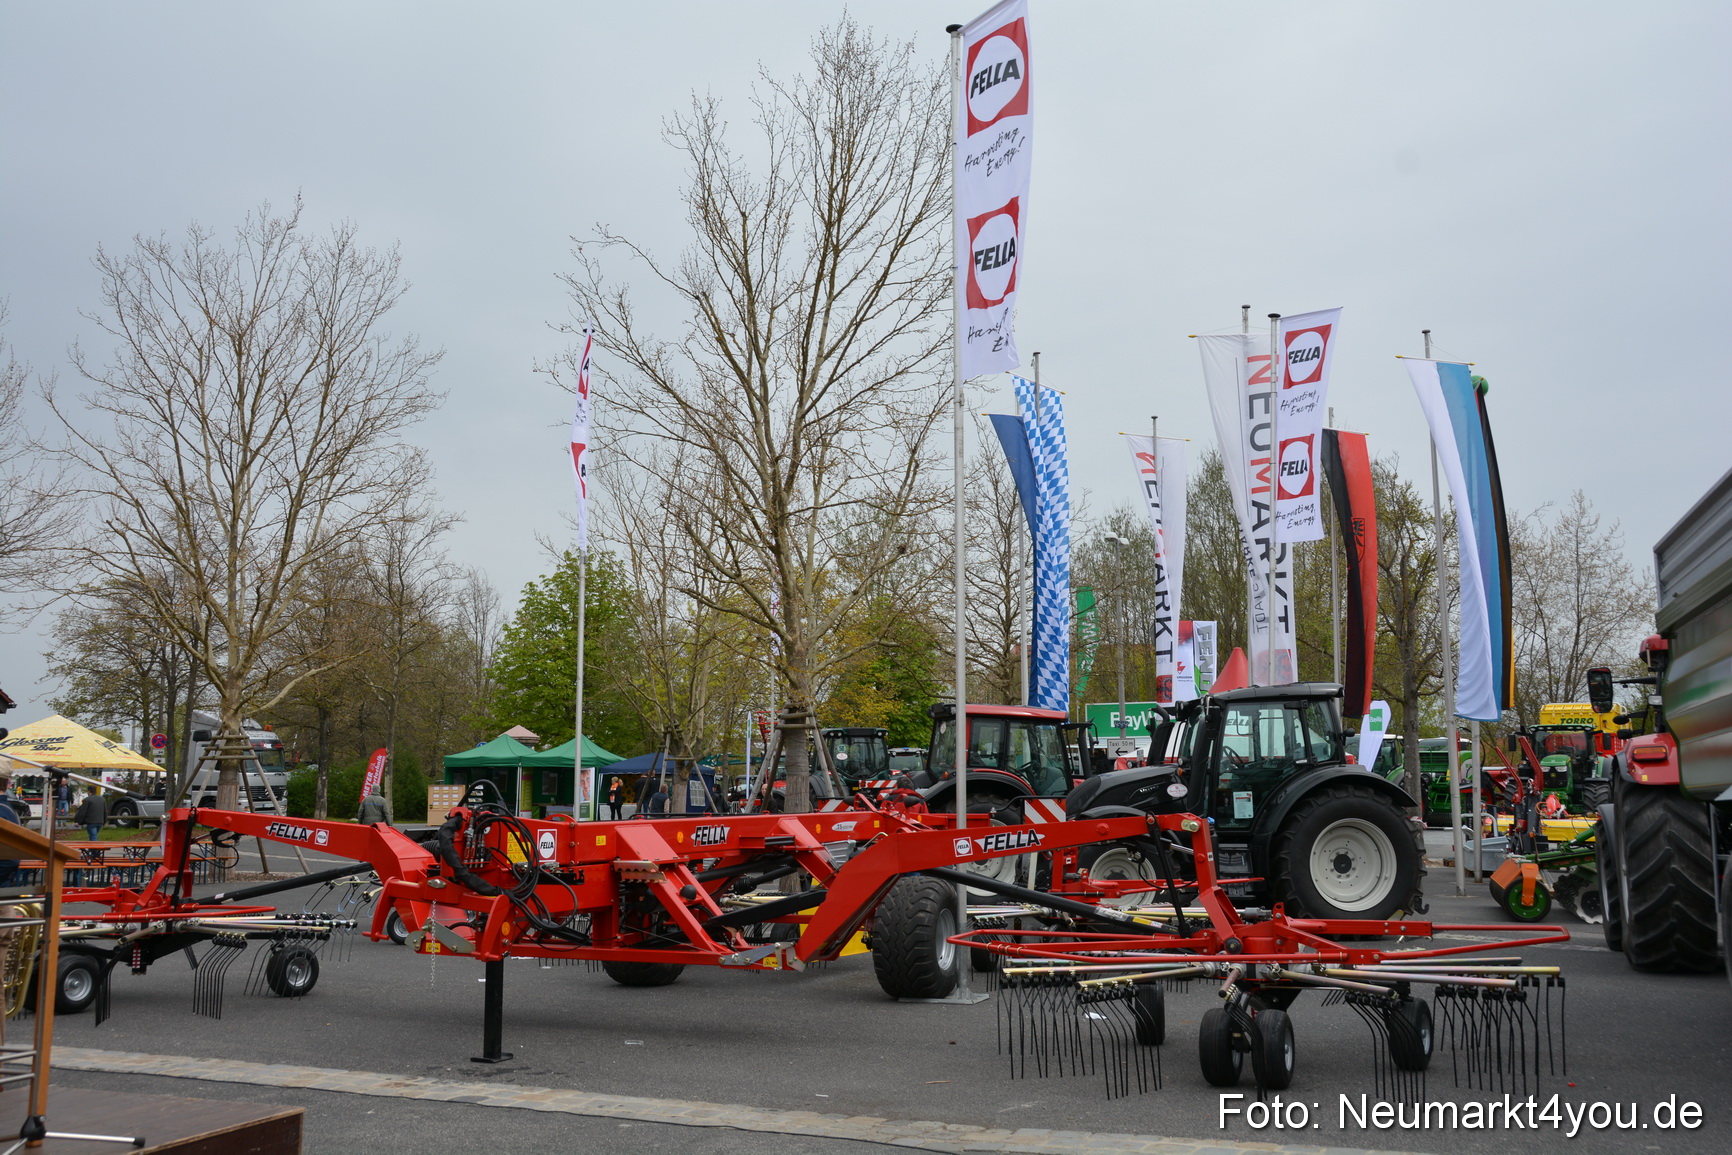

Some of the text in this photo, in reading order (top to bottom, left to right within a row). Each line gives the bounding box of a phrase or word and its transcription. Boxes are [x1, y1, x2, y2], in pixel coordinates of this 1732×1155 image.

[970, 58, 1021, 100] FELLA
[965, 127, 1019, 172] Harvesting
[987, 136, 1025, 177] Energy!
[974, 236, 1016, 272] FELLA
[1288, 345, 1321, 365] FELLA
[1280, 389, 1317, 411] Harvesting
[1110, 710, 1154, 731] BayW
[362, 771, 373, 797] MEYER
[268, 821, 308, 842] FELLA
[694, 824, 727, 847] FELLA
[983, 829, 1041, 853] FELLA
[540, 841, 554, 849] FELLA
